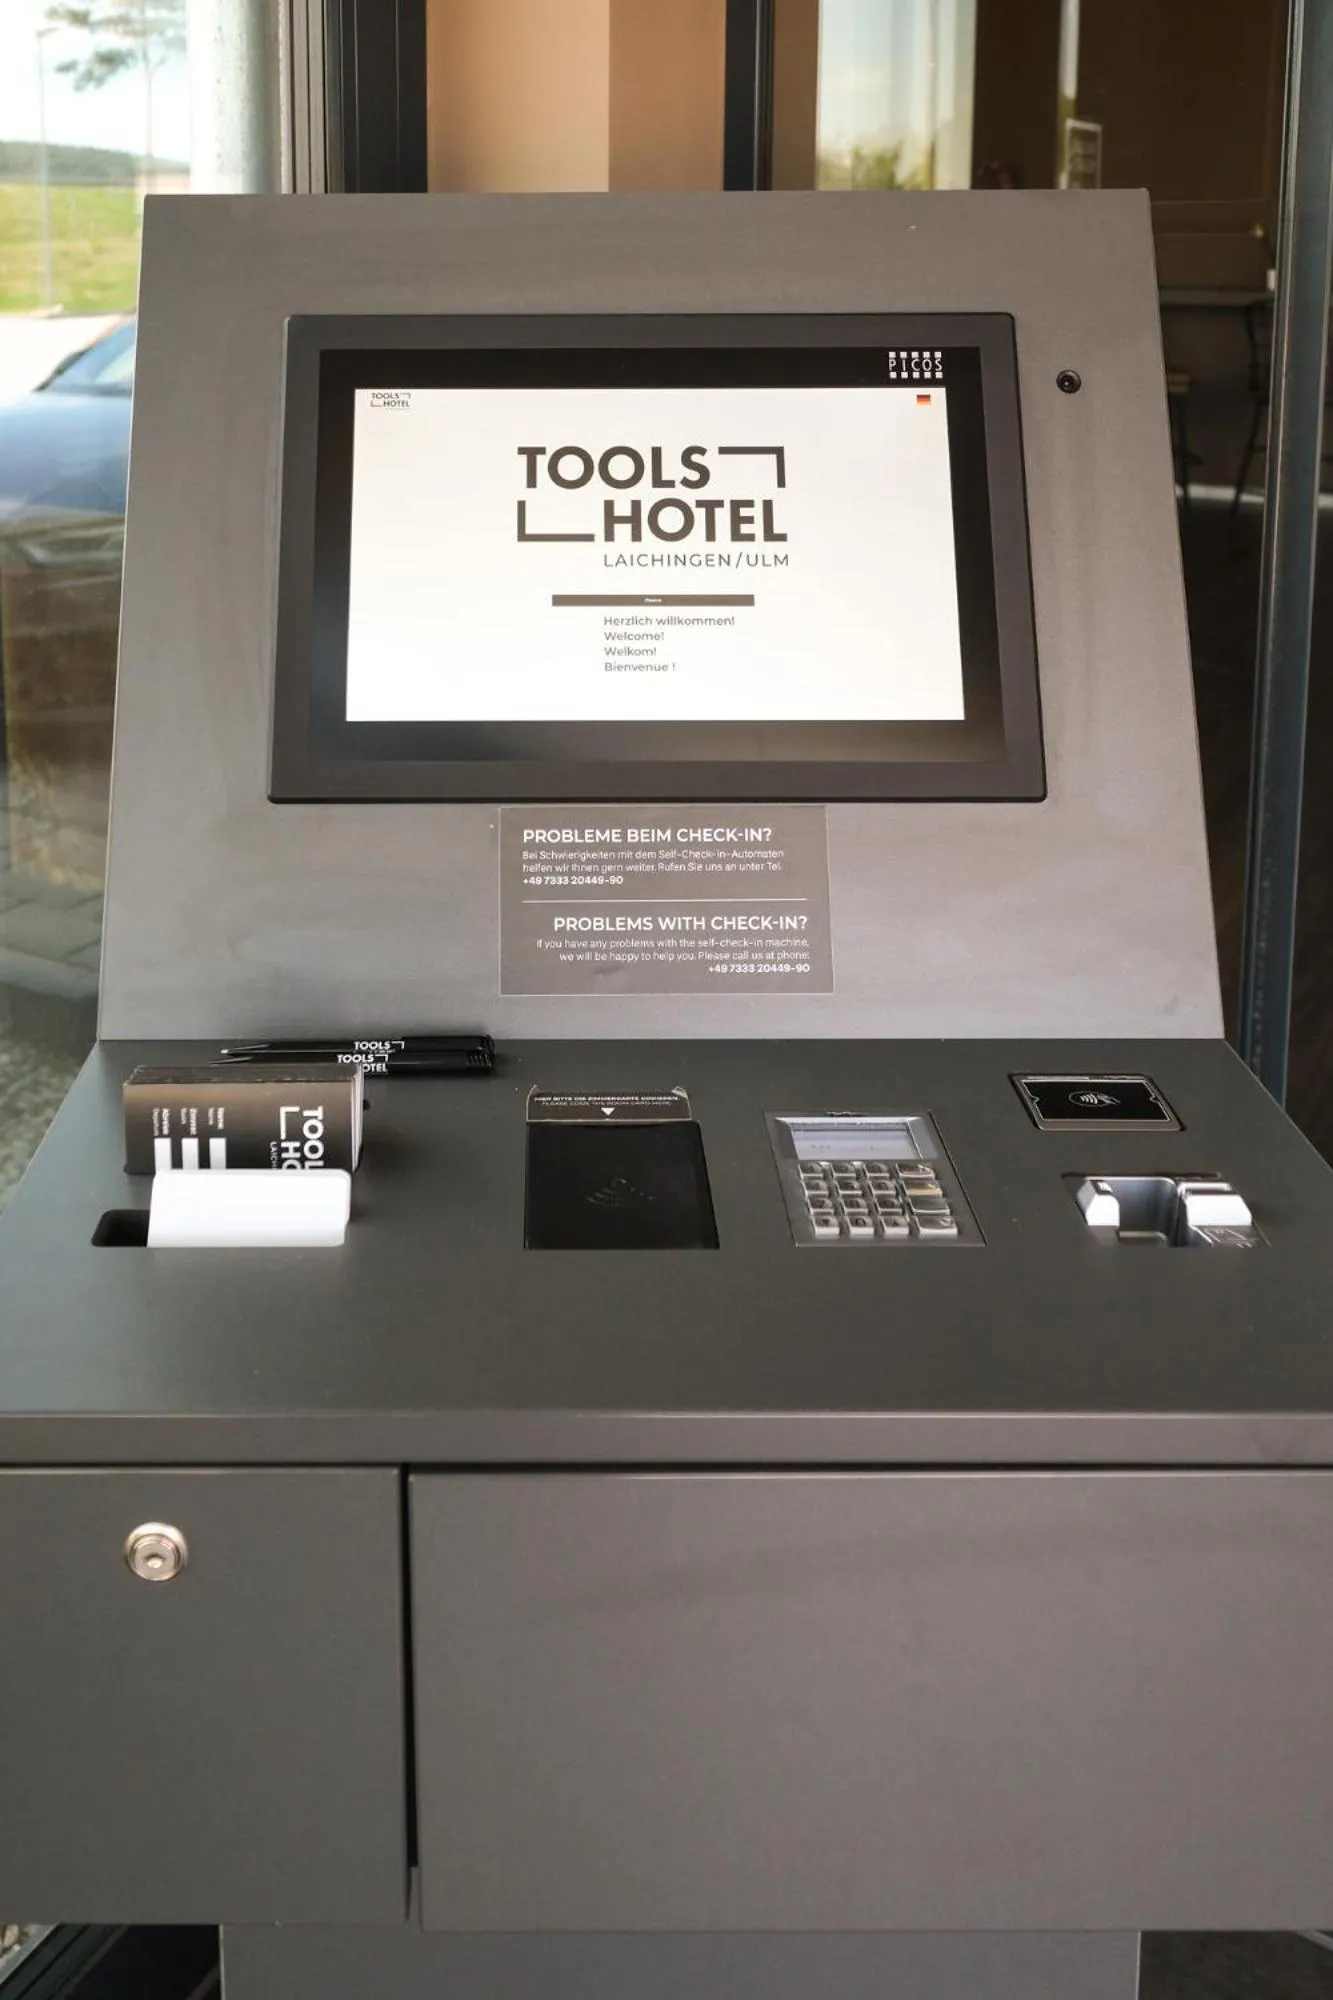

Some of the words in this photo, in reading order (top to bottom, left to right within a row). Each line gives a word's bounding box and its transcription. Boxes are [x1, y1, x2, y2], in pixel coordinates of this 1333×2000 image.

[371, 392, 400, 400] TOOLS
[383, 399, 411, 407] HOTEL
[517, 445, 711, 490] TOOLS
[603, 497, 788, 542] HOTEL
[603, 552, 790, 568] LAICHINGEN/ULM
[603, 615, 653, 626] Herzlich
[655, 615, 735, 626] willkommen!
[603, 631, 665, 641] Welcome!
[603, 646, 657, 657] Welkom!
[603, 661, 669, 672] Bienvenue
[523, 829, 622, 843] PROBLEME
[627, 829, 672, 842] BEIM
[676, 827, 773, 842] CHECK-IN?
[522, 850, 538, 860] Bei
[539, 849, 616, 862] Schwierigkeiten
[617, 850, 633, 860] mit
[635, 849, 657, 860] dem
[522, 863, 552, 873] helfen
[554, 864, 570, 873] wir
[571, 863, 600, 873] Ihnen
[601, 864, 623, 875] gern
[657, 862, 686, 872] Rufen
[687, 862, 703, 872] Sie
[704, 863, 723, 872] uns
[724, 863, 737, 872] an
[739, 863, 765, 872] unter
[523, 875, 542, 885] +49
[544, 875, 569, 885] 7333
[570, 875, 624, 885] 20449-90
[553, 917, 654, 931] PROBLEMS
[658, 917, 706, 930] WITH
[711, 915, 808, 930] CHECK-IN?
[544, 940, 562, 950] you
[564, 939, 587, 949] have
[589, 939, 607, 950] any
[609, 938, 655, 950] problems
[657, 938, 678, 948] with
[679, 937, 696, 948] the
[559, 952, 575, 961] we
[576, 951, 593, 961] will
[595, 951, 608, 961] be
[609, 951, 640, 963] happy
[641, 951, 652, 961] to
[653, 951, 675, 963] help
[698, 950, 730, 960] Please
[732, 950, 750, 960] call
[751, 951, 764, 960] us
[765, 950, 775, 960] at
[708, 964, 728, 974] +49
[729, 963, 755, 973] 7333
[757, 963, 811, 973] 20449-90
[354, 1040, 391, 1050] TOOLS
[337, 1053, 375, 1064] TOOLS
[362, 1062, 388, 1073] OTEL
[302, 1105, 325, 1170] TOOL
